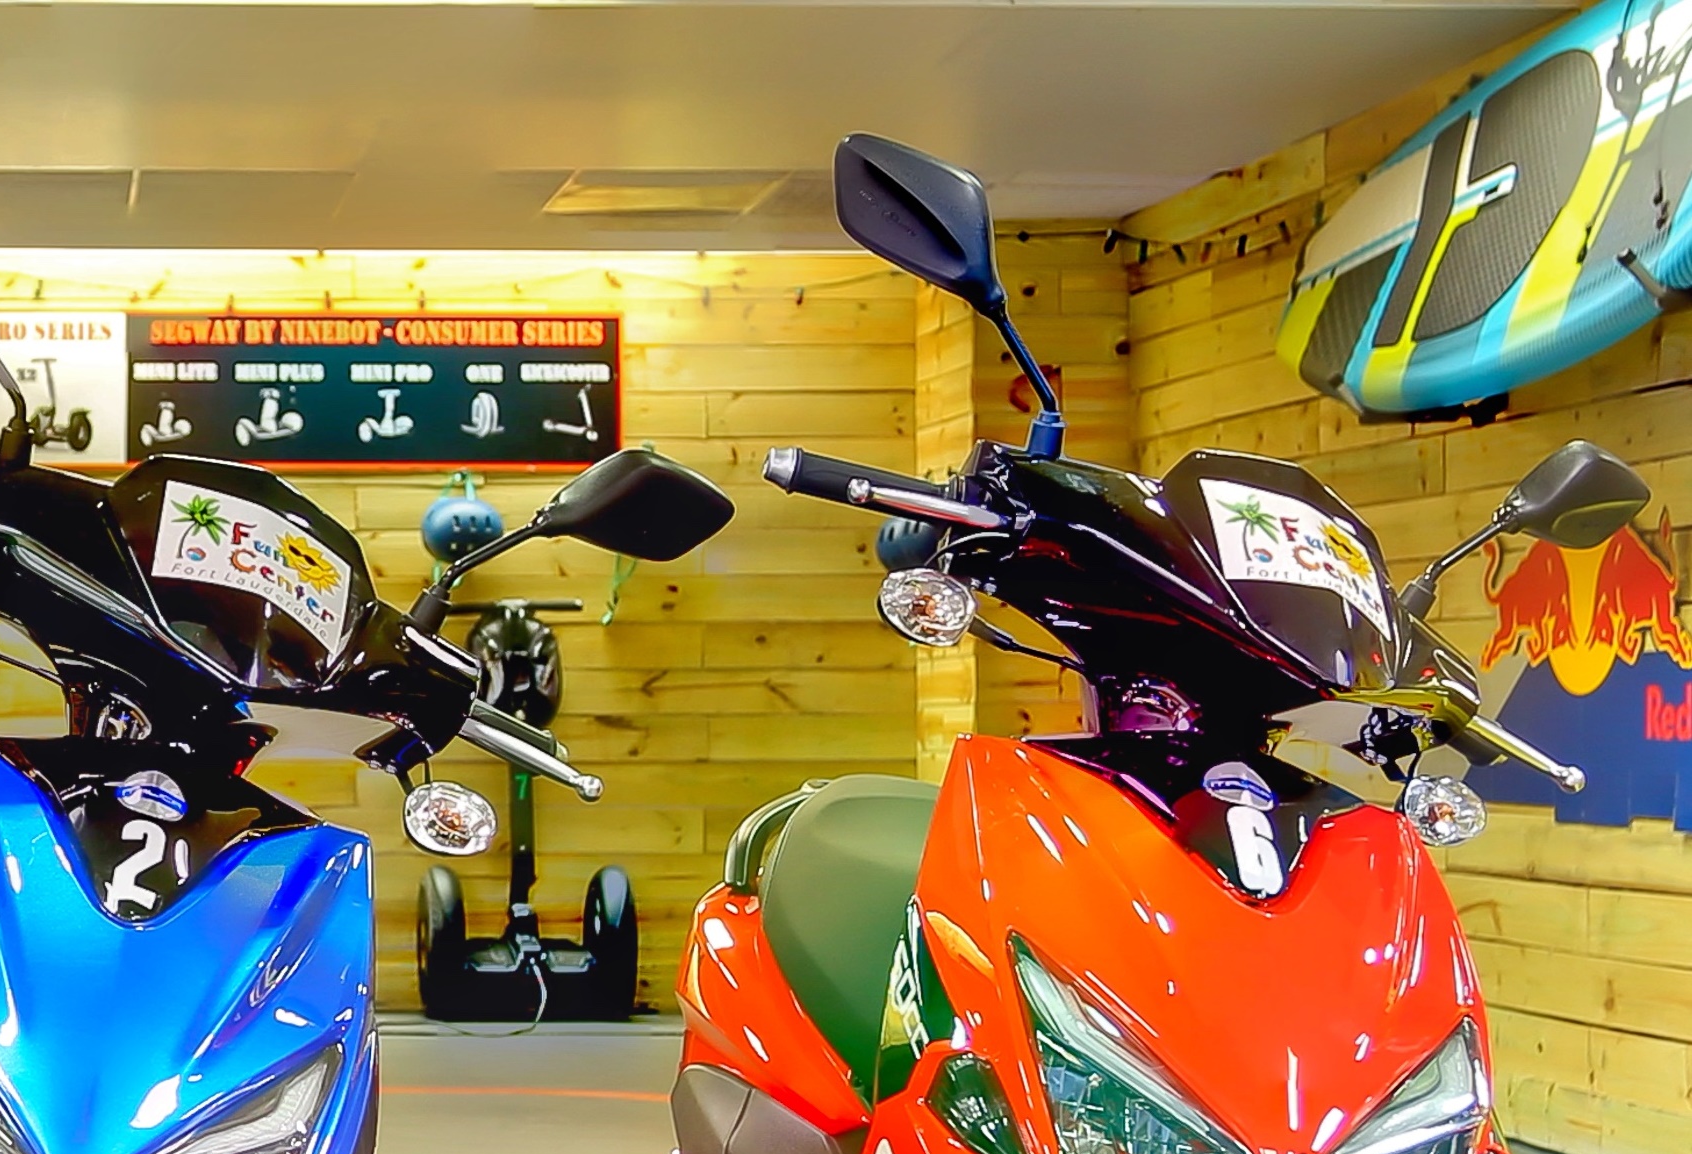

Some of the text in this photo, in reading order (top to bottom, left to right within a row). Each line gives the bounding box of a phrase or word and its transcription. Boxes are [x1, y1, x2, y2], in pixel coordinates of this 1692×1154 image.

[34, 321, 112, 341] SERIES
[150, 319, 604, 346] SEGWAY BY NINEBOT CONSUMER SERIES
[231, 522, 290, 568] Fun
[1280, 517, 1340, 559] Fun
[228, 548, 336, 624] Center
[1246, 566, 1289, 579] Fort
[171, 564, 328, 639] Fort Lauderdale
[1645, 683, 1692, 741] Red
[107, 819, 167, 911] 2
[1226, 805, 1283, 895] 6
